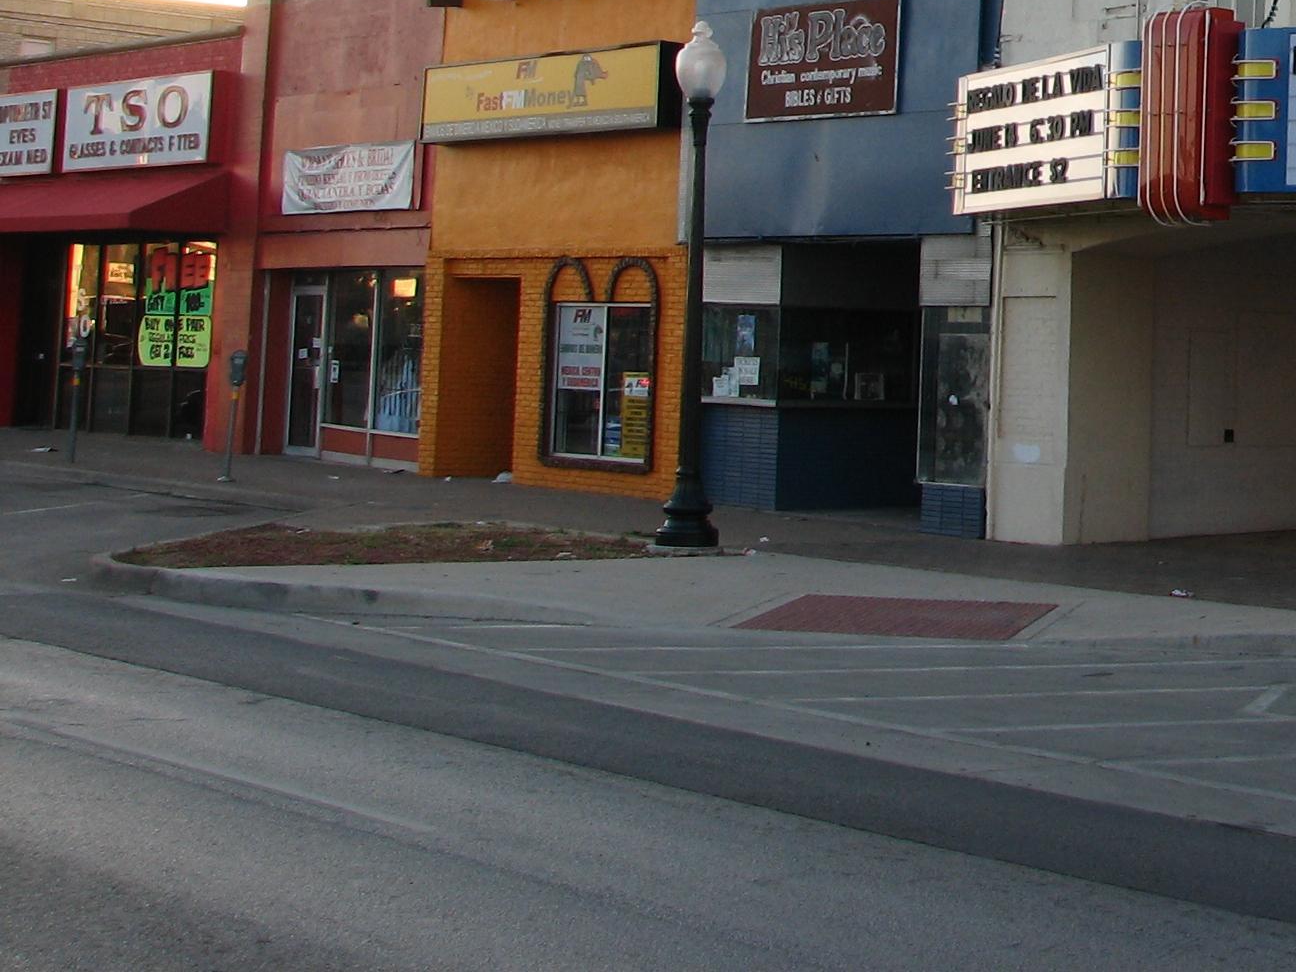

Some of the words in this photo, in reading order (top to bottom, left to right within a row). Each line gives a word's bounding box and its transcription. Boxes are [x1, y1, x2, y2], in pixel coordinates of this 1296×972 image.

[805, 8, 885, 62] Place
[800, 68, 857, 85] contemporary
[1043, 71, 1065, 100] LA
[1069, 64, 1103, 94] VIDA
[785, 88, 815, 107] BIBLES
[824, 87, 852, 104] GIFTS
[83, 85, 190, 135] TSO
[9, 128, 36, 145] EYES
[70, 140, 106, 159] GLASSES
[119, 136, 164, 155] CONTACTS
[966, 125, 1003, 153] JUNE
